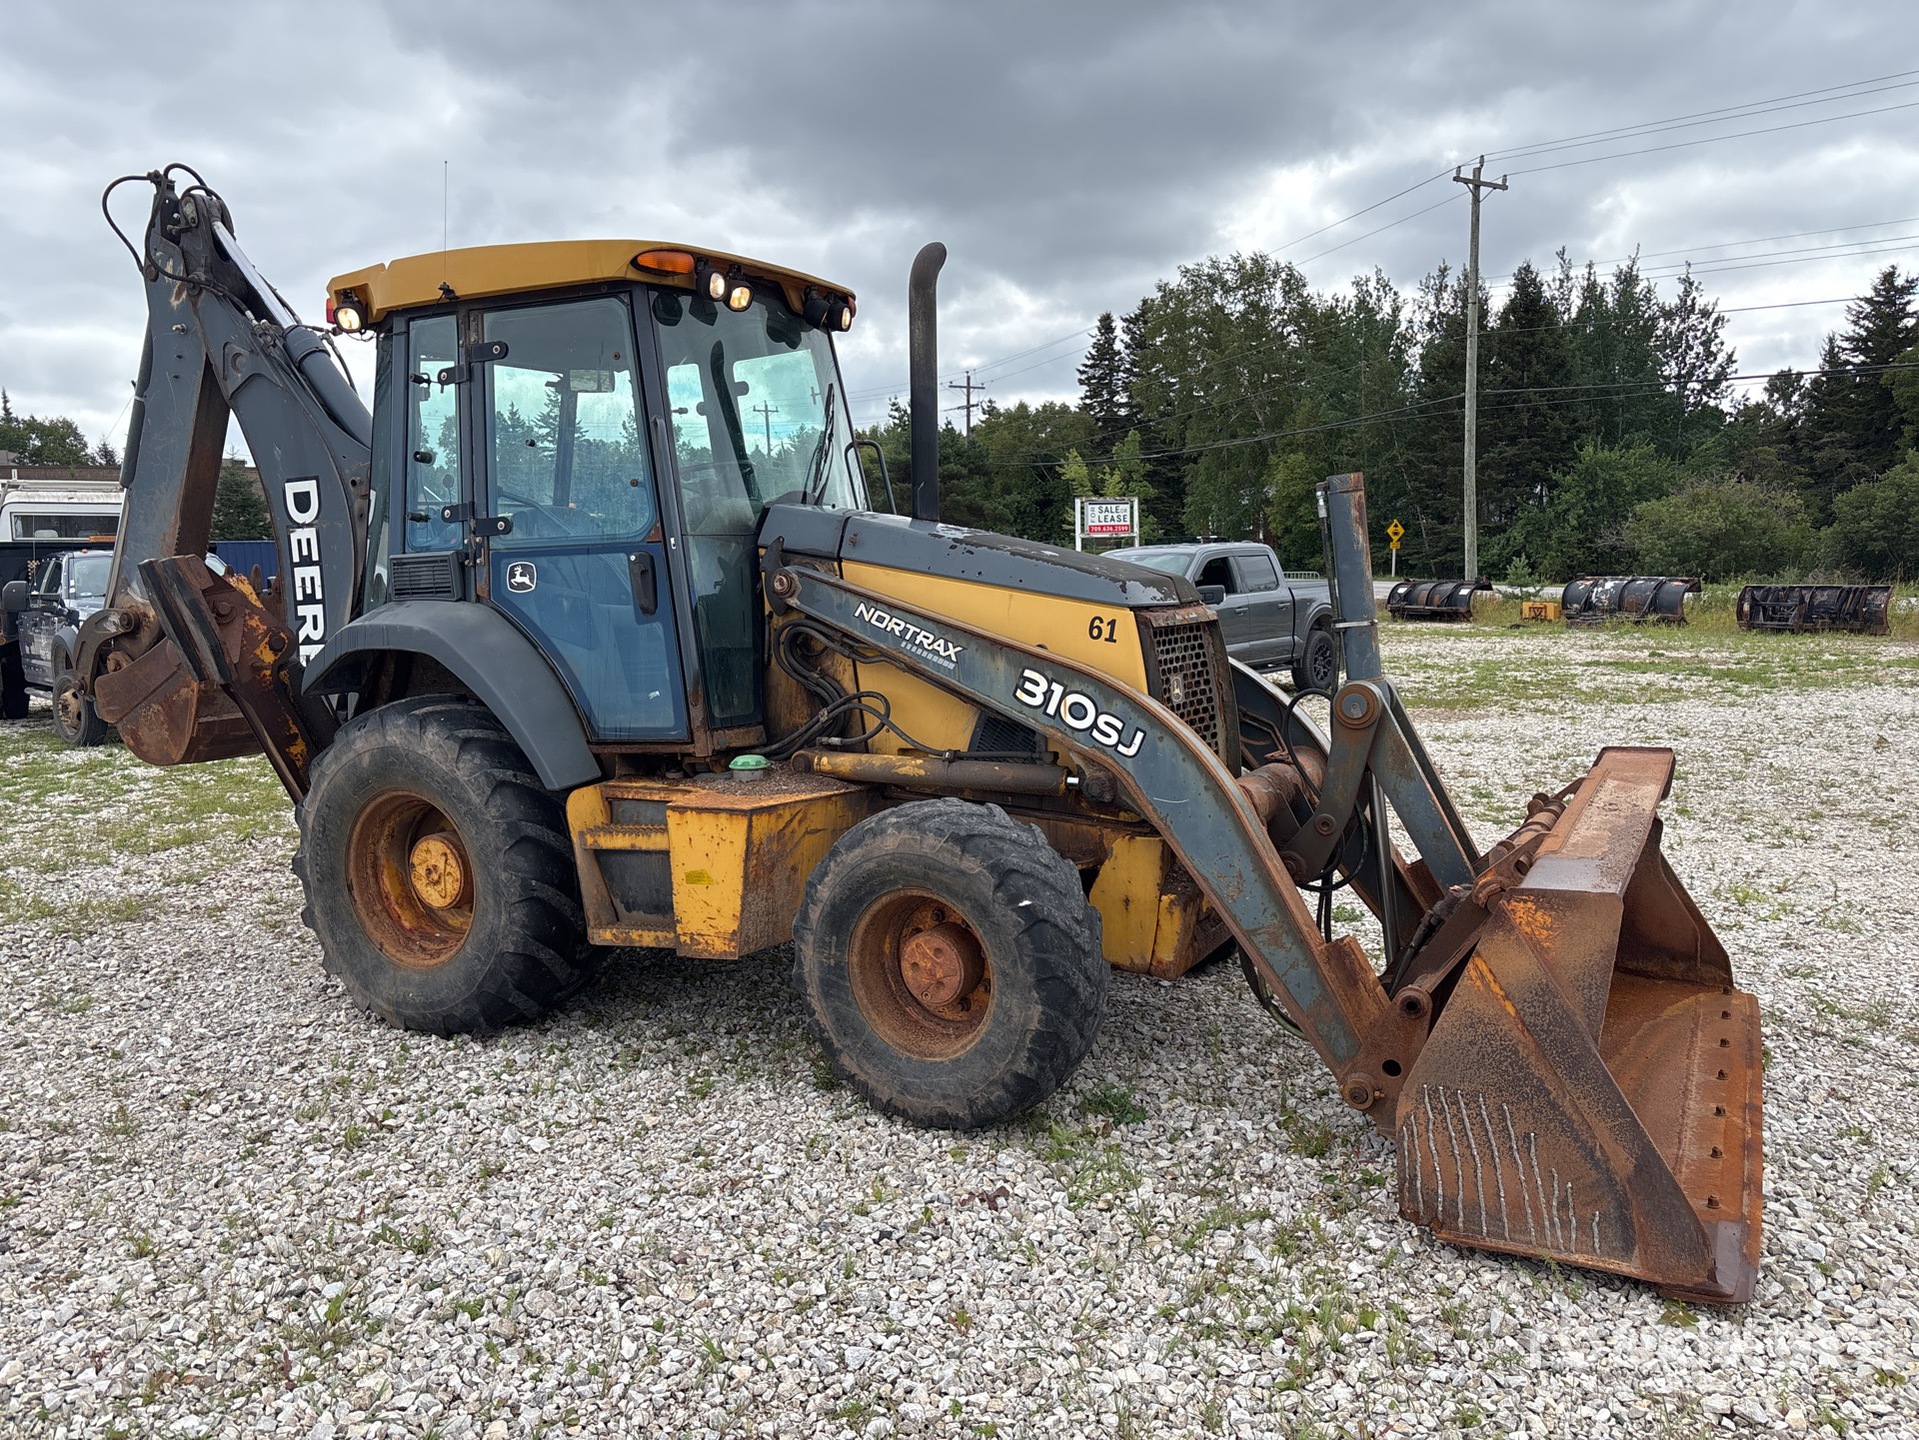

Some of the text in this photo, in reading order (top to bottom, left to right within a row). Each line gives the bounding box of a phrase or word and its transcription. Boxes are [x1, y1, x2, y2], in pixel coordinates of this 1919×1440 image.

[1098, 506, 1120, 514] SALE
[1098, 515, 1128, 523] LEASE
[853, 601, 963, 663] NORTRAX
[1087, 615, 1118, 644] 61
[1014, 667, 1146, 758] 310SJ
